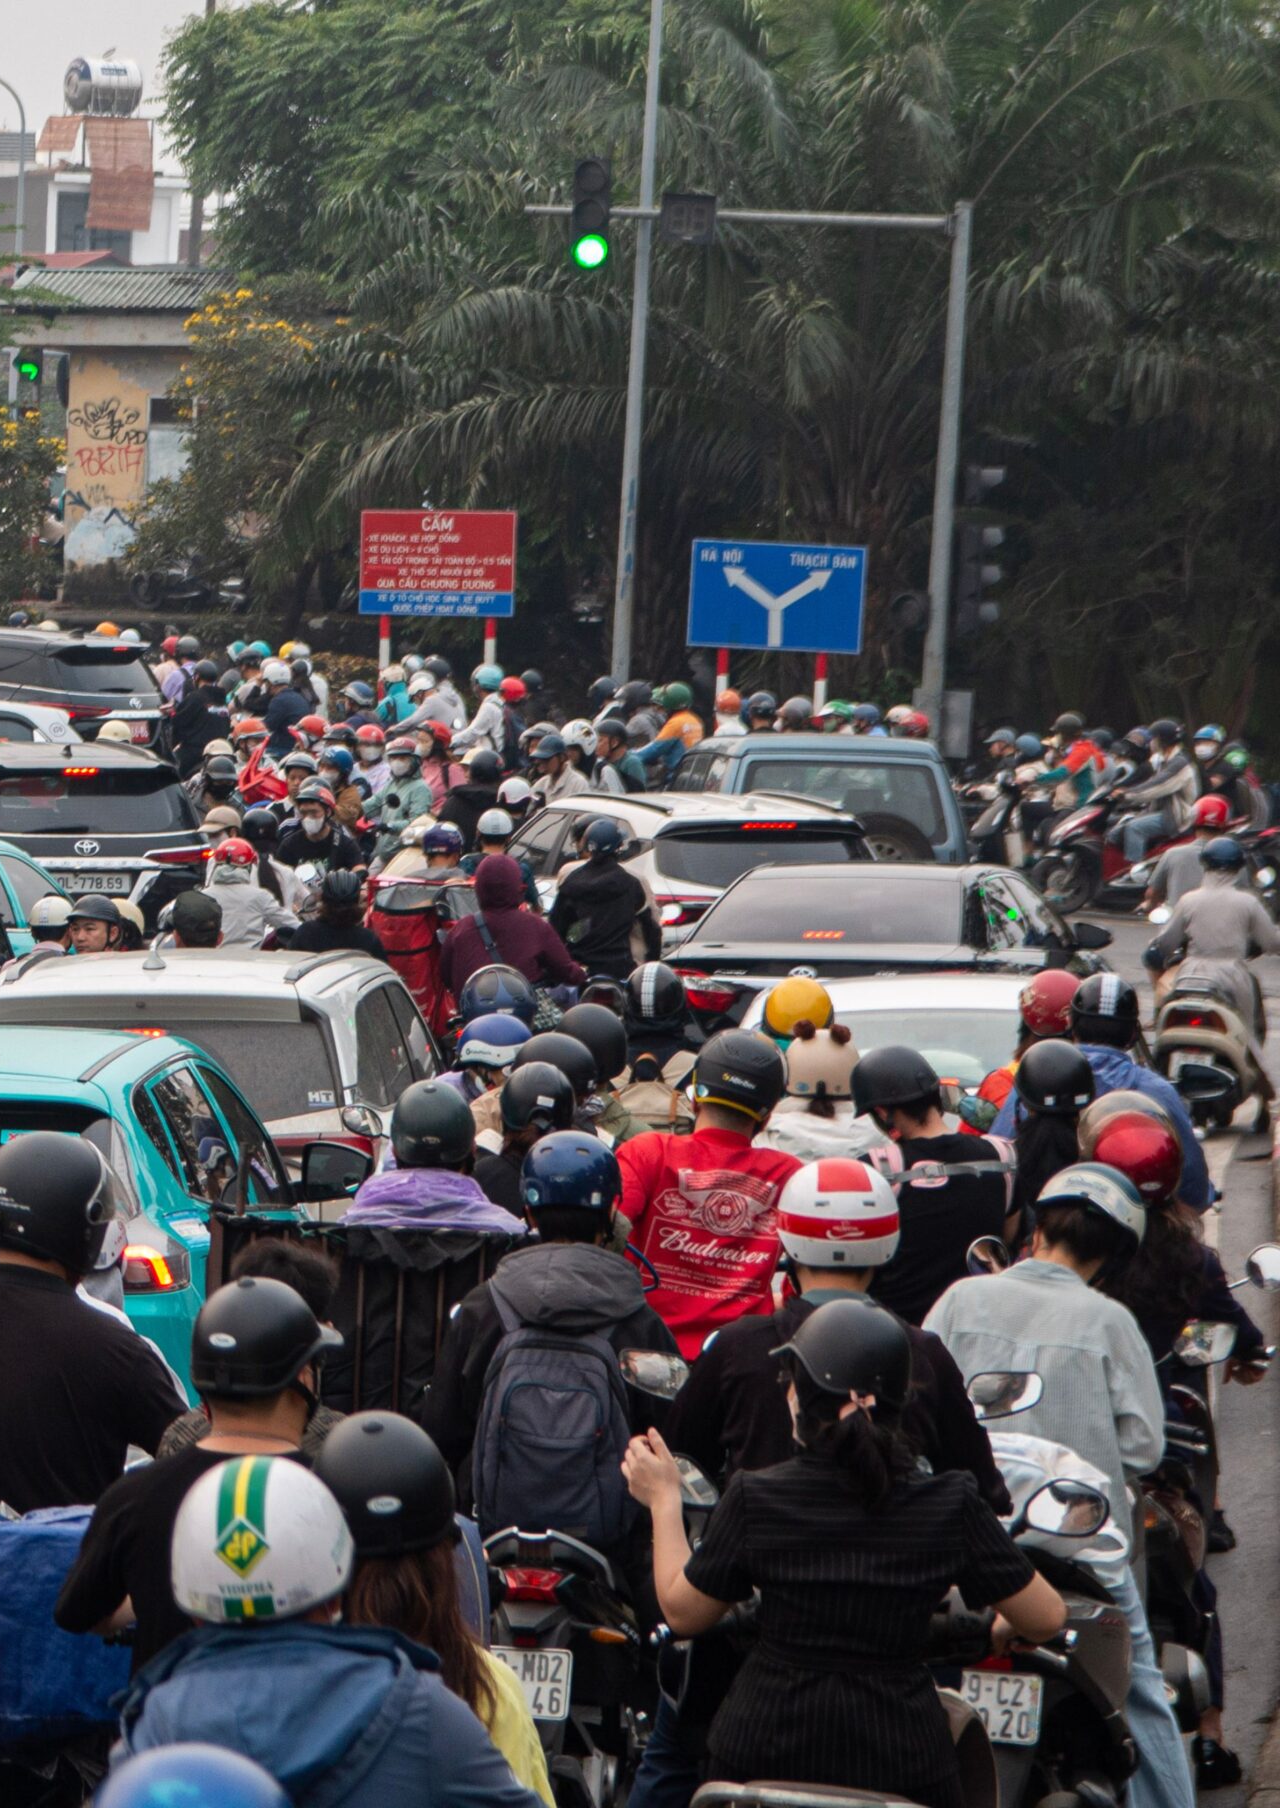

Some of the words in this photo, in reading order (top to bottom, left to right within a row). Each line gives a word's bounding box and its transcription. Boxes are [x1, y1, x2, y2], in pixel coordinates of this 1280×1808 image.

[421, 512, 455, 532] CẤM
[377, 579, 396, 589] QUA
[56, 877, 123, 890] 0L-778.69
[659, 1227, 771, 1265] Budweiser
[680, 1255, 701, 1265] KING
[703, 1260, 715, 1268] OF
[966, 1673, 1024, 1707] 9-C2
